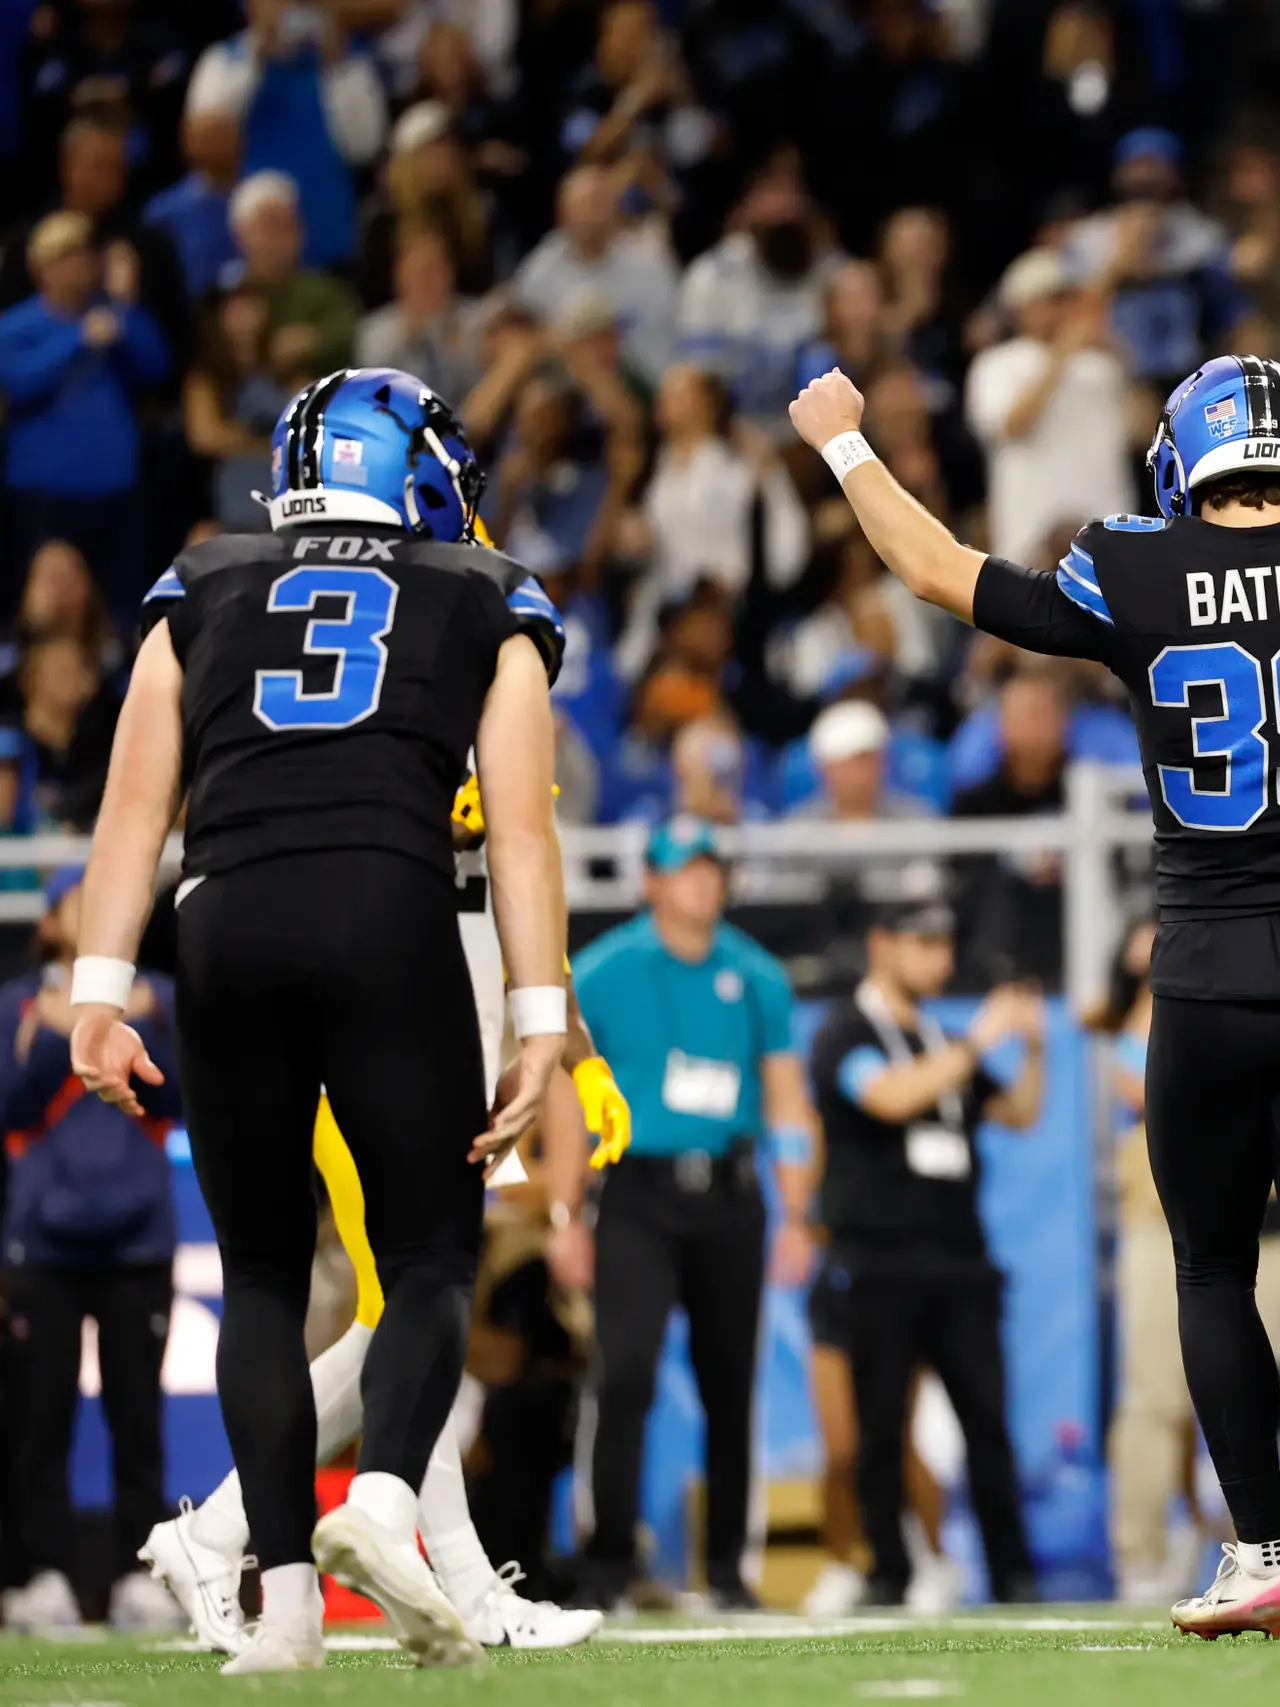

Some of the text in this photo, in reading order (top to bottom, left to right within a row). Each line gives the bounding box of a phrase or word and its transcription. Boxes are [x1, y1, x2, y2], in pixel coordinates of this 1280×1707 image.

[282, 497, 327, 517] LIONS
[292, 536, 402, 562] FOX
[252, 564, 400, 733] 3
